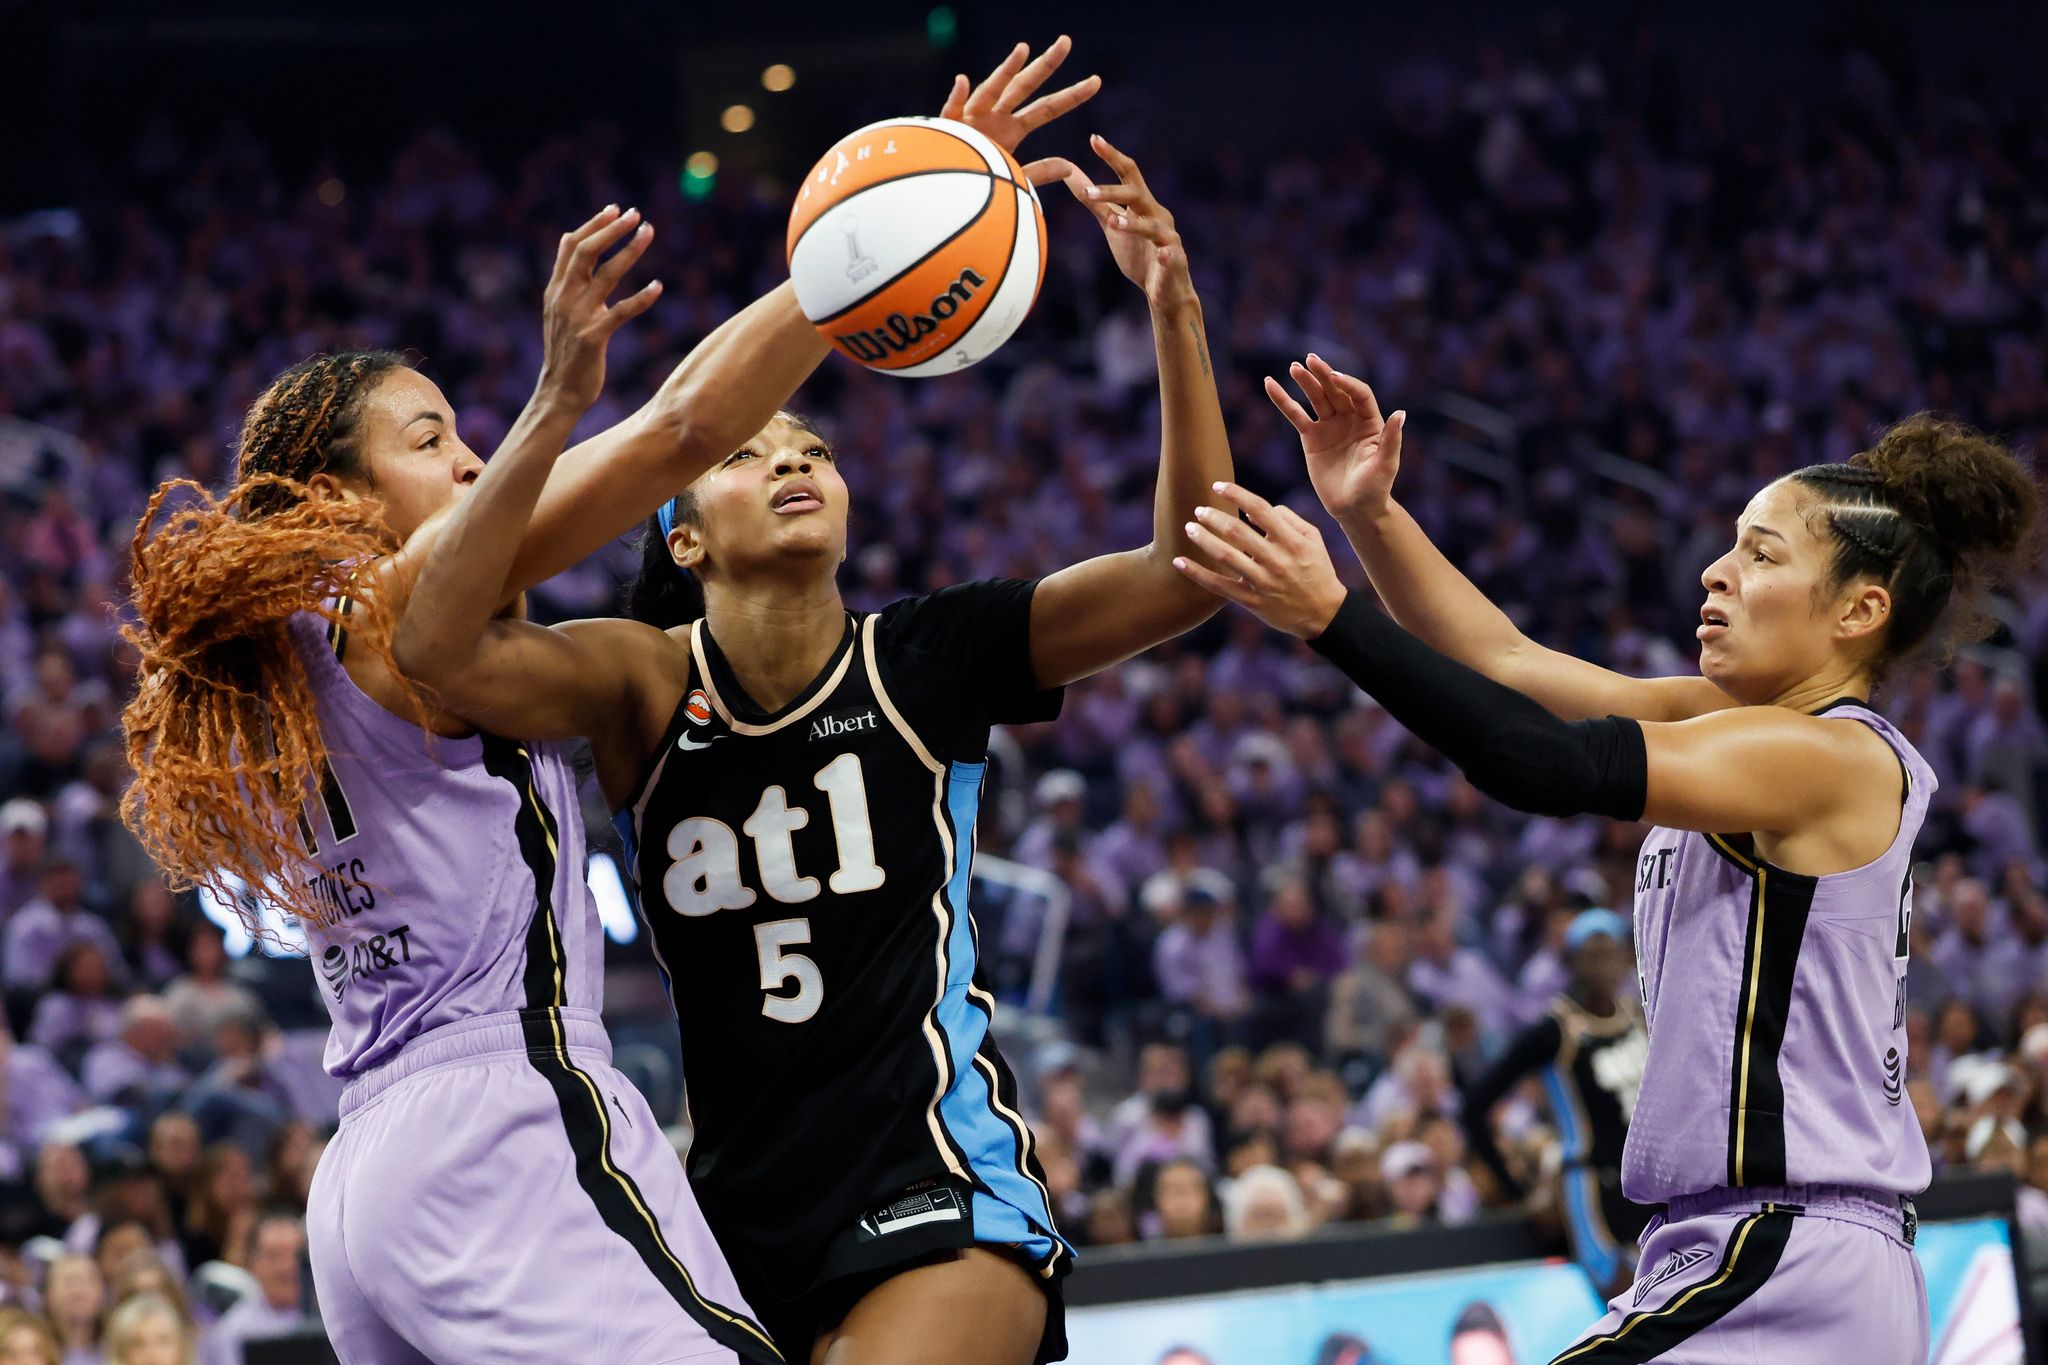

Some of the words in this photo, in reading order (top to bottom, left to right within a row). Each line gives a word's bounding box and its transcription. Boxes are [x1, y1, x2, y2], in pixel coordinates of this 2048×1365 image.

[835, 267, 986, 362] Wilson
[808, 711, 878, 742] Albert
[753, 917, 824, 1024] 5
